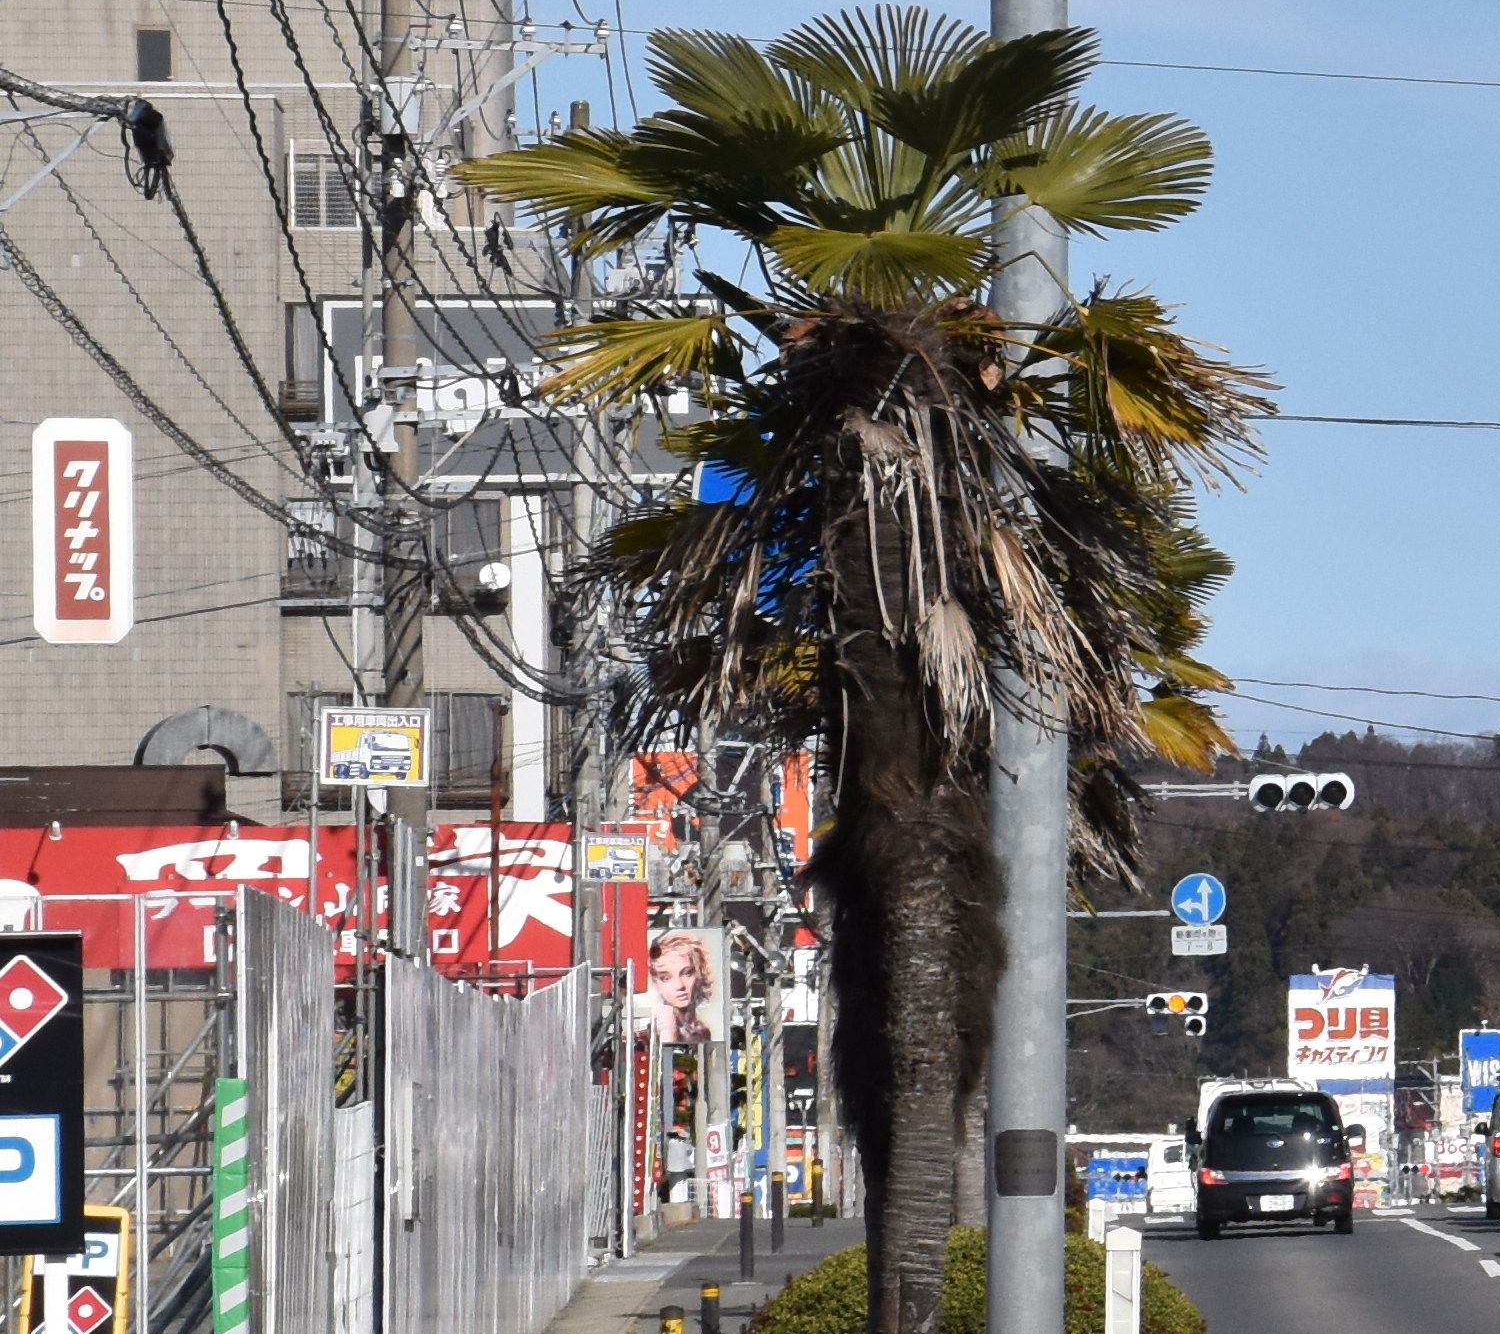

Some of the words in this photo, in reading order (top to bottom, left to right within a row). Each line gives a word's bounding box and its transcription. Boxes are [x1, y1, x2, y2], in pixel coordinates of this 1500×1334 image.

[63, 461, 105, 601] クリナップ
[1294, 1007, 1390, 1041] つり具
